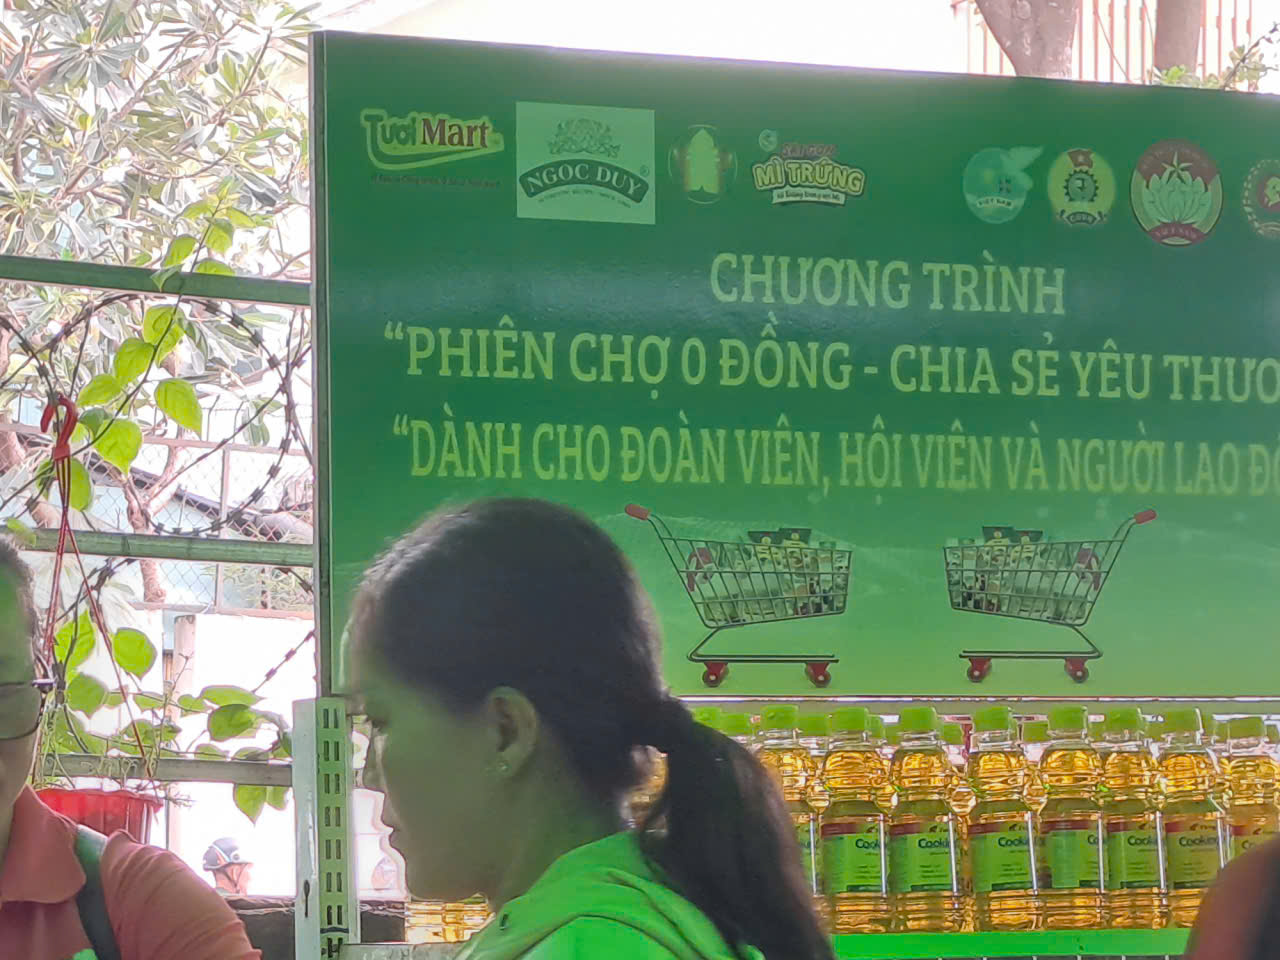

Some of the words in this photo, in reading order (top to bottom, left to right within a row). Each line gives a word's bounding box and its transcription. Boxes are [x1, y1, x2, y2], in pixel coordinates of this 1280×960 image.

[420, 117, 490, 149] Mart
[596, 165, 641, 196] DUY
[754, 158, 784, 188] MÌ
[709, 252, 912, 310] CHƯƠNG
[921, 249, 1066, 316] TRÌNH
[568, 332, 672, 400] CHỢ
[718, 310, 853, 392] ĐỒNG
[889, 343, 1001, 394] CHIA
[1010, 331, 1061, 398] SẺ
[1069, 338, 1153, 400] YÊU
[531, 422, 611, 482] CHO
[620, 410, 727, 484] ĐOÀN
[838, 414, 904, 505] HỘI
[910, 418, 994, 492] VIÊN
[1000, 420, 1050, 491] VÀ
[1057, 420, 1167, 495] NGƯỜI
[1174, 441, 1241, 496] LAO
